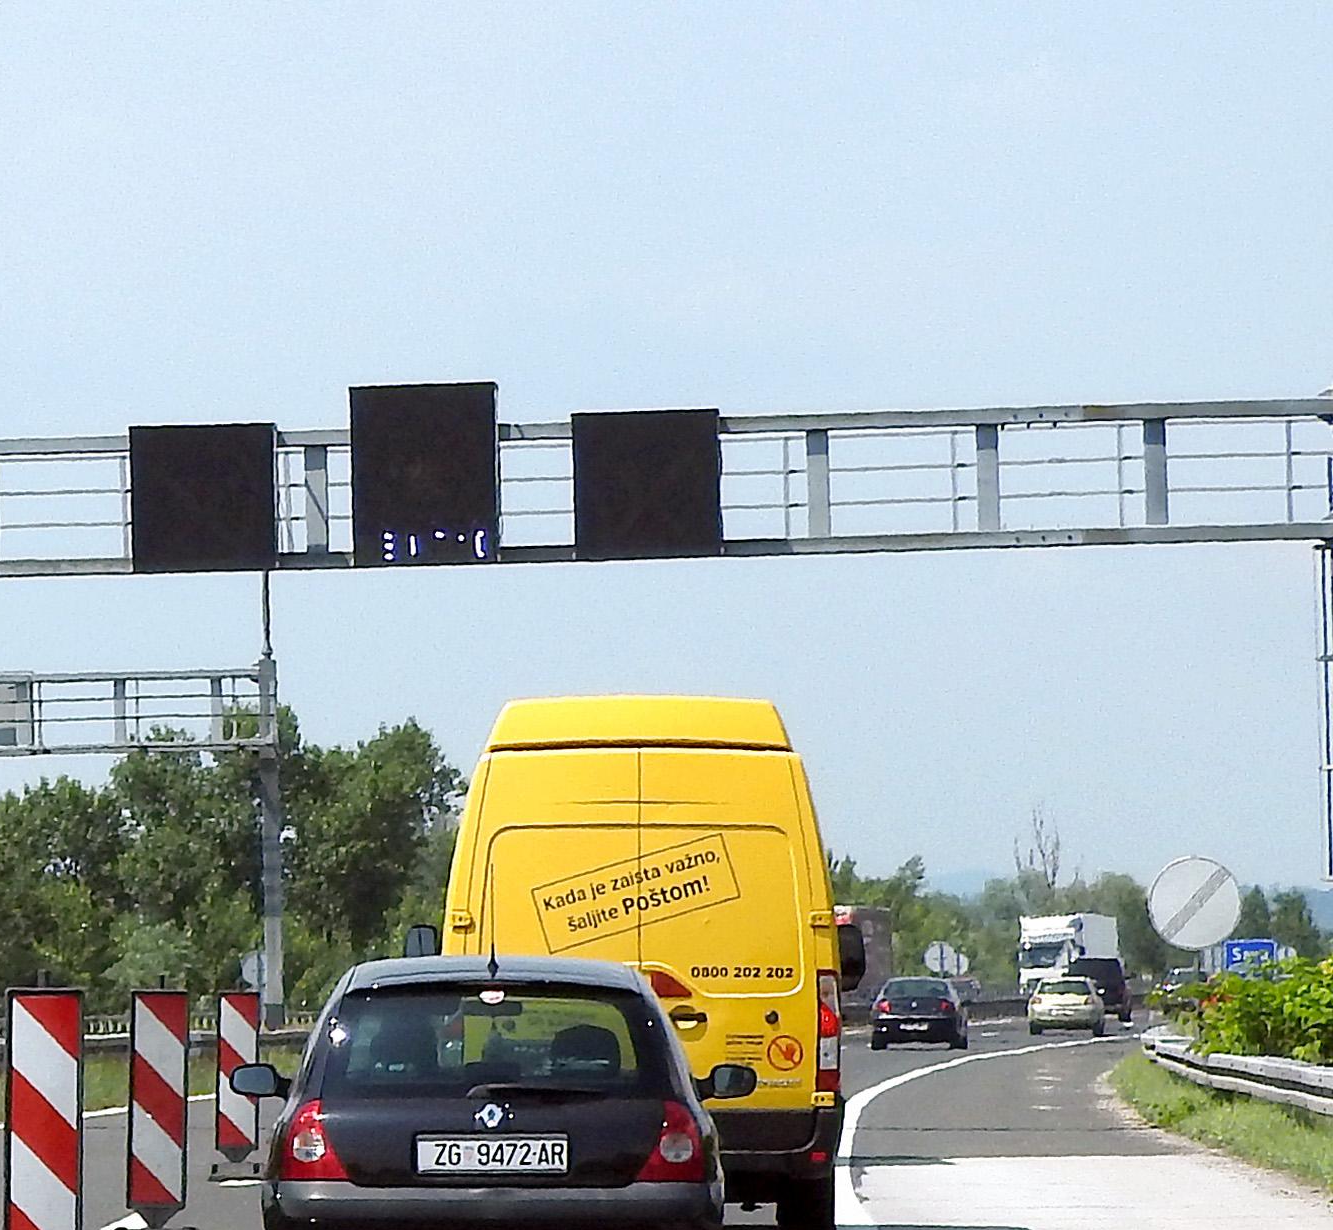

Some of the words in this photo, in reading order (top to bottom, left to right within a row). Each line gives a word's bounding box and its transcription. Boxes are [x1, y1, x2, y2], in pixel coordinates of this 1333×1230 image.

[543, 888, 587, 911] Kada
[589, 882, 606, 900] je
[611, 866, 662, 892] zaista
[664, 849, 721, 875] važno,
[567, 906, 618, 933] šaljite
[621, 875, 711, 915] Poštom!
[691, 966, 728, 978] 0800
[733, 966, 761, 978] 202
[766, 966, 794, 979] 202
[434, 1143, 462, 1166] ZG
